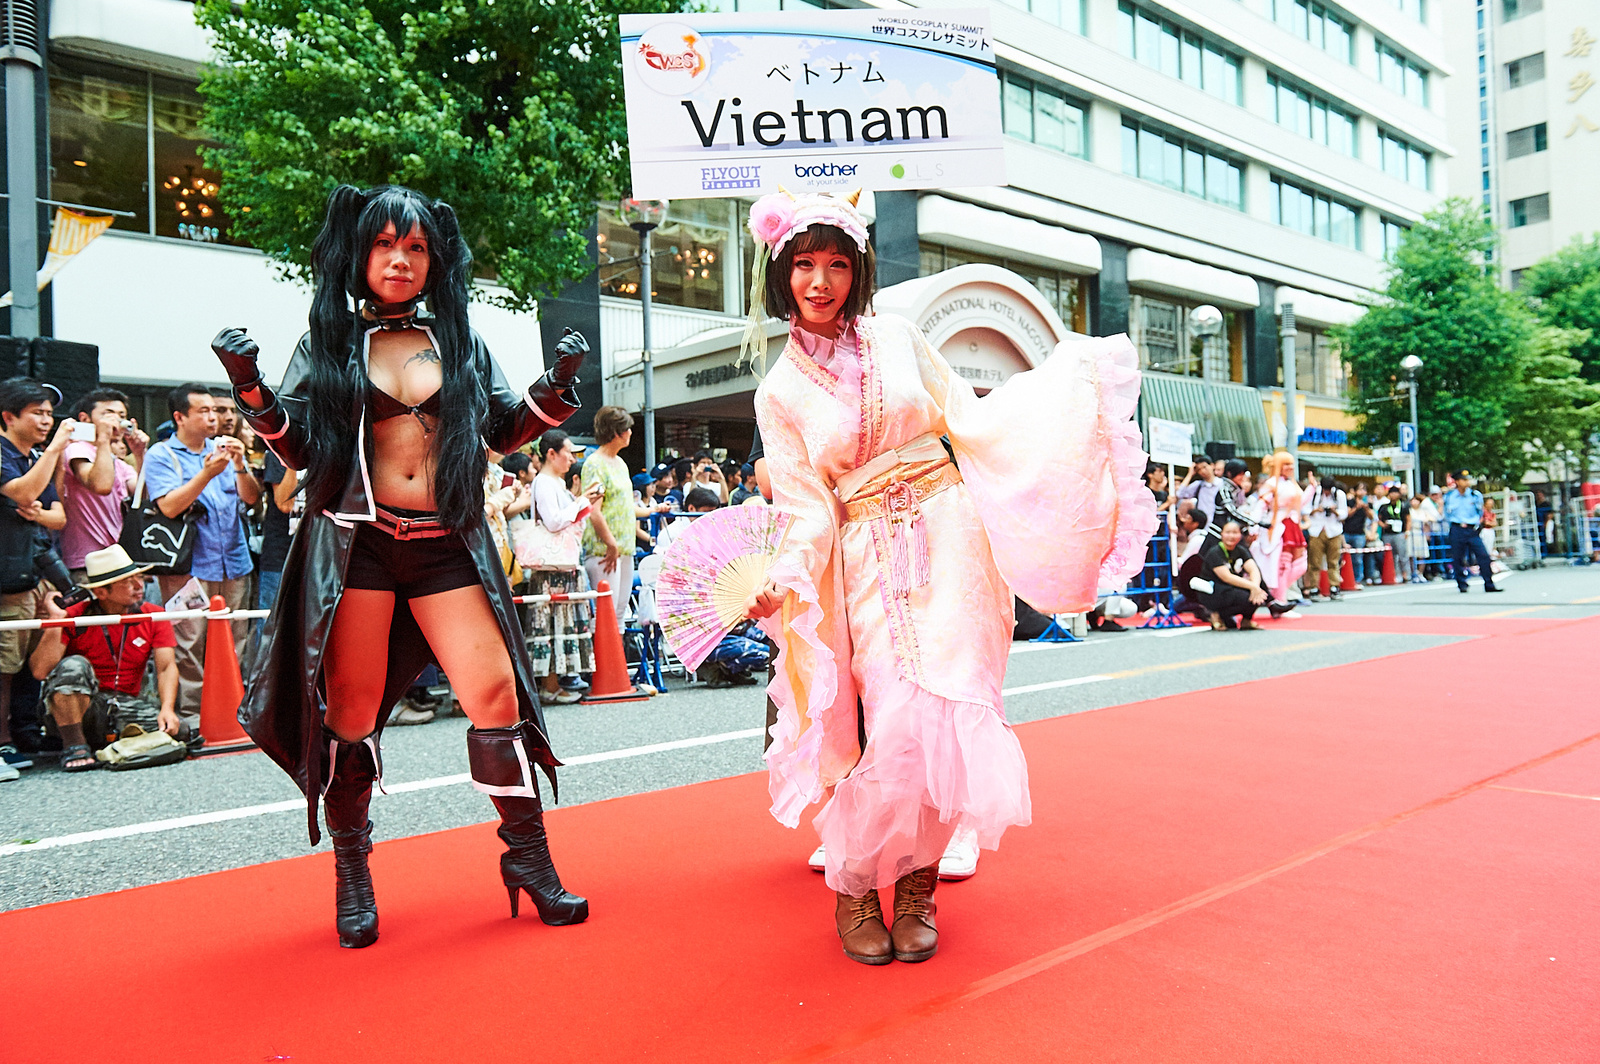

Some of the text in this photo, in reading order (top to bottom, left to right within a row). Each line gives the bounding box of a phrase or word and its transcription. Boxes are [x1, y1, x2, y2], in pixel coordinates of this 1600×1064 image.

[910, 19, 949, 29] COSPLAY
[951, 23, 985, 35] SUMMIT
[872, 25, 990, 51] 世界コスプレサミット
[767, 61, 885, 84] ベトナム
[681, 98, 949, 147] Vietnam
[701, 165, 761, 180] FLYOUT
[795, 163, 858, 177] brother
[703, 179, 760, 189] Planning
[815, 178, 833, 187] your
[833, 177, 849, 185] side
[921, 298, 1049, 360] NTERNATIONAL HOTEL NAGOYA
[1402, 426, 1414, 451] P
